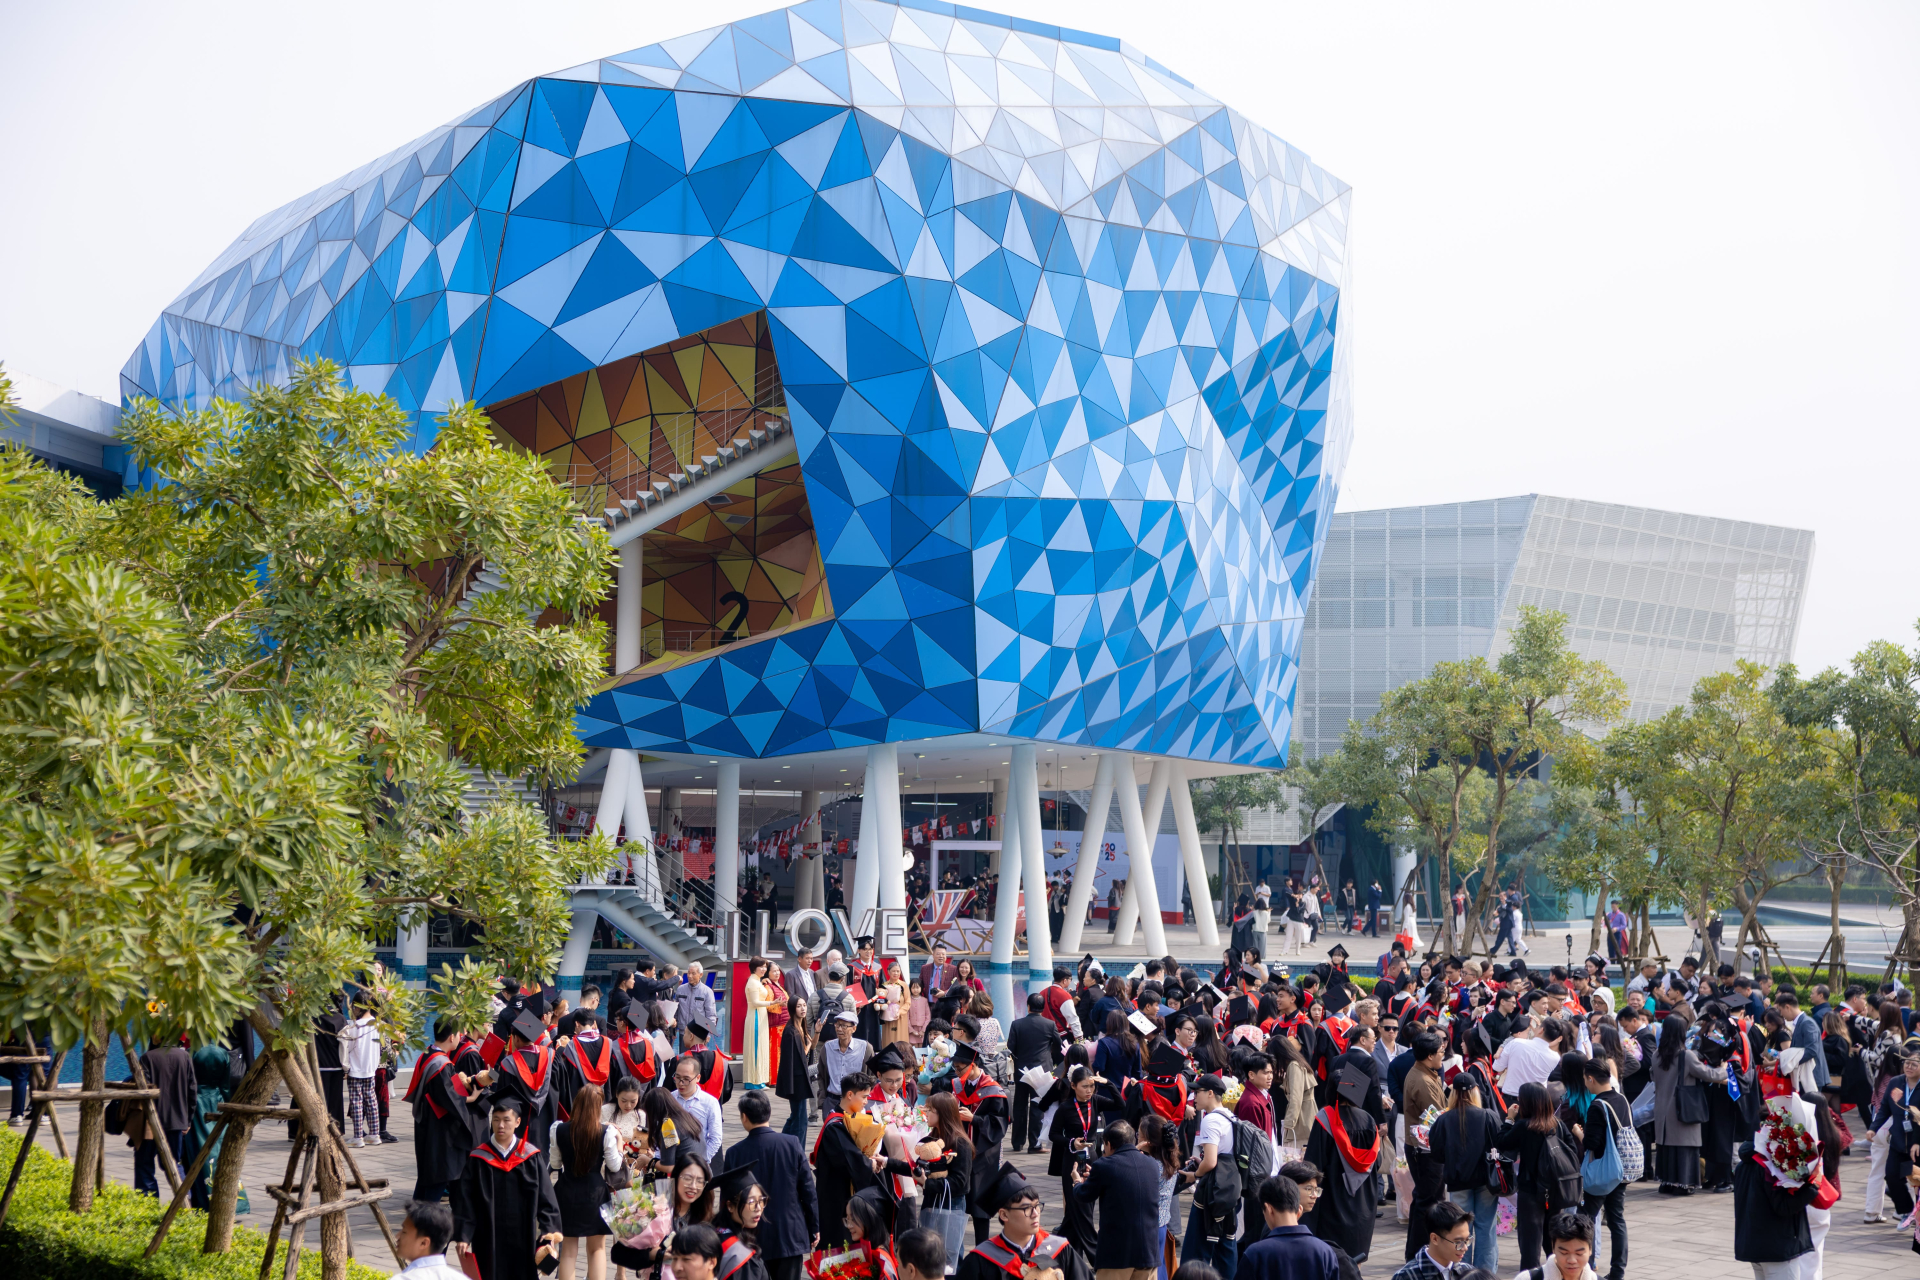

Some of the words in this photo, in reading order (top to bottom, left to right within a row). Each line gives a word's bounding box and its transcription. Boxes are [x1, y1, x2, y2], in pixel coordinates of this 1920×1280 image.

[718, 591, 749, 646] 2
[728, 910, 741, 959] I
[756, 908, 908, 960] LOVE
